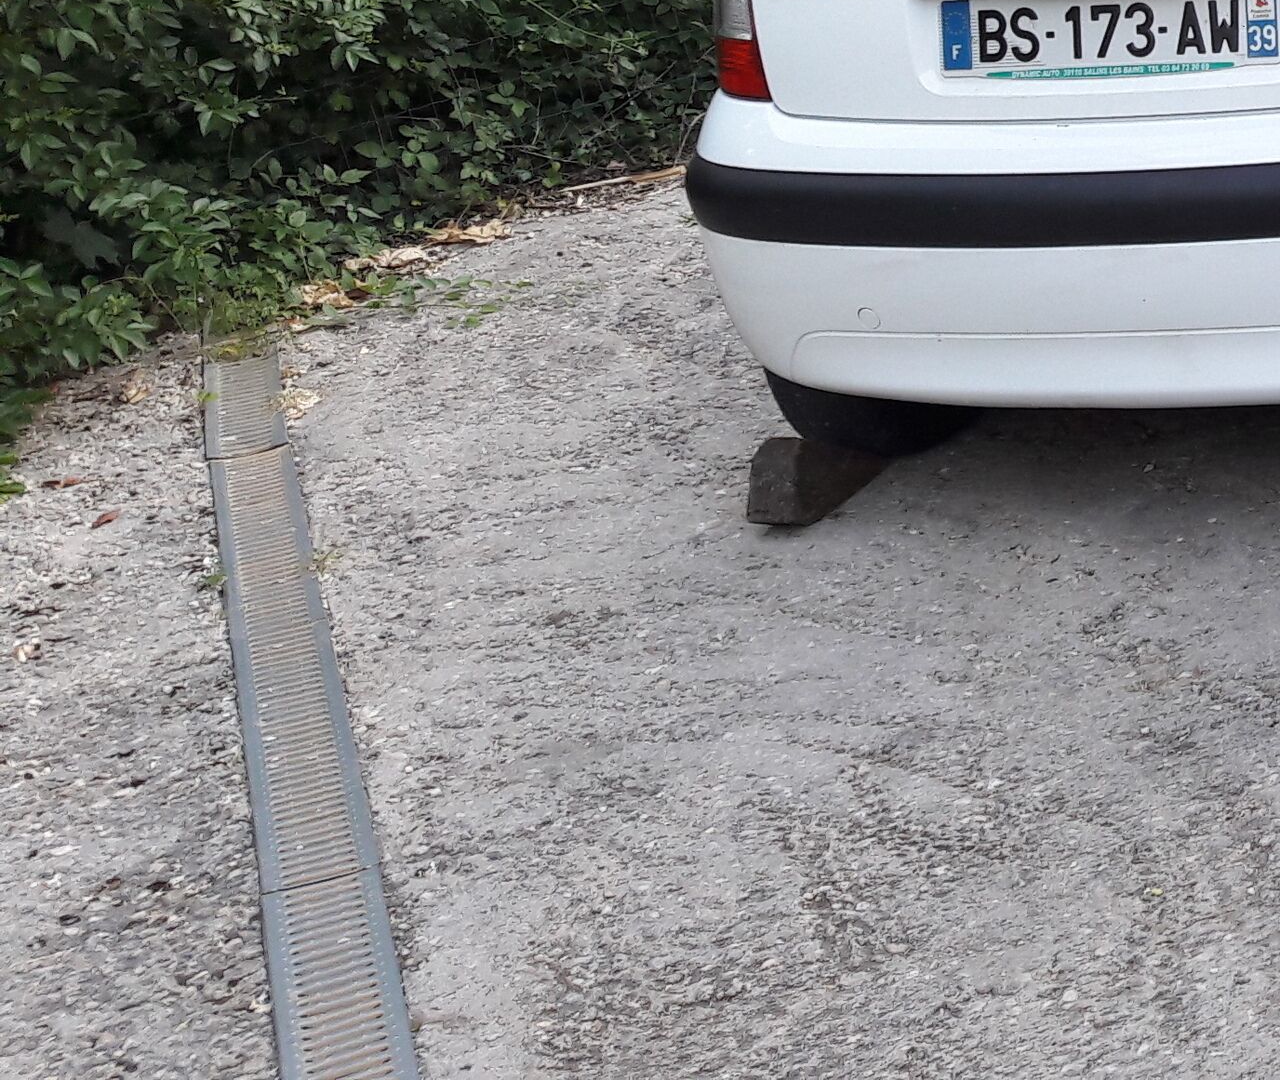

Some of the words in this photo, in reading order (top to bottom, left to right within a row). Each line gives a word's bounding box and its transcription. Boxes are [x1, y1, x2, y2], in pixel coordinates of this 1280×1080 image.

[978, 0, 1239, 63] BS-173-AW
[1249, 24, 1276, 52] 39
[952, 44, 962, 60] F
